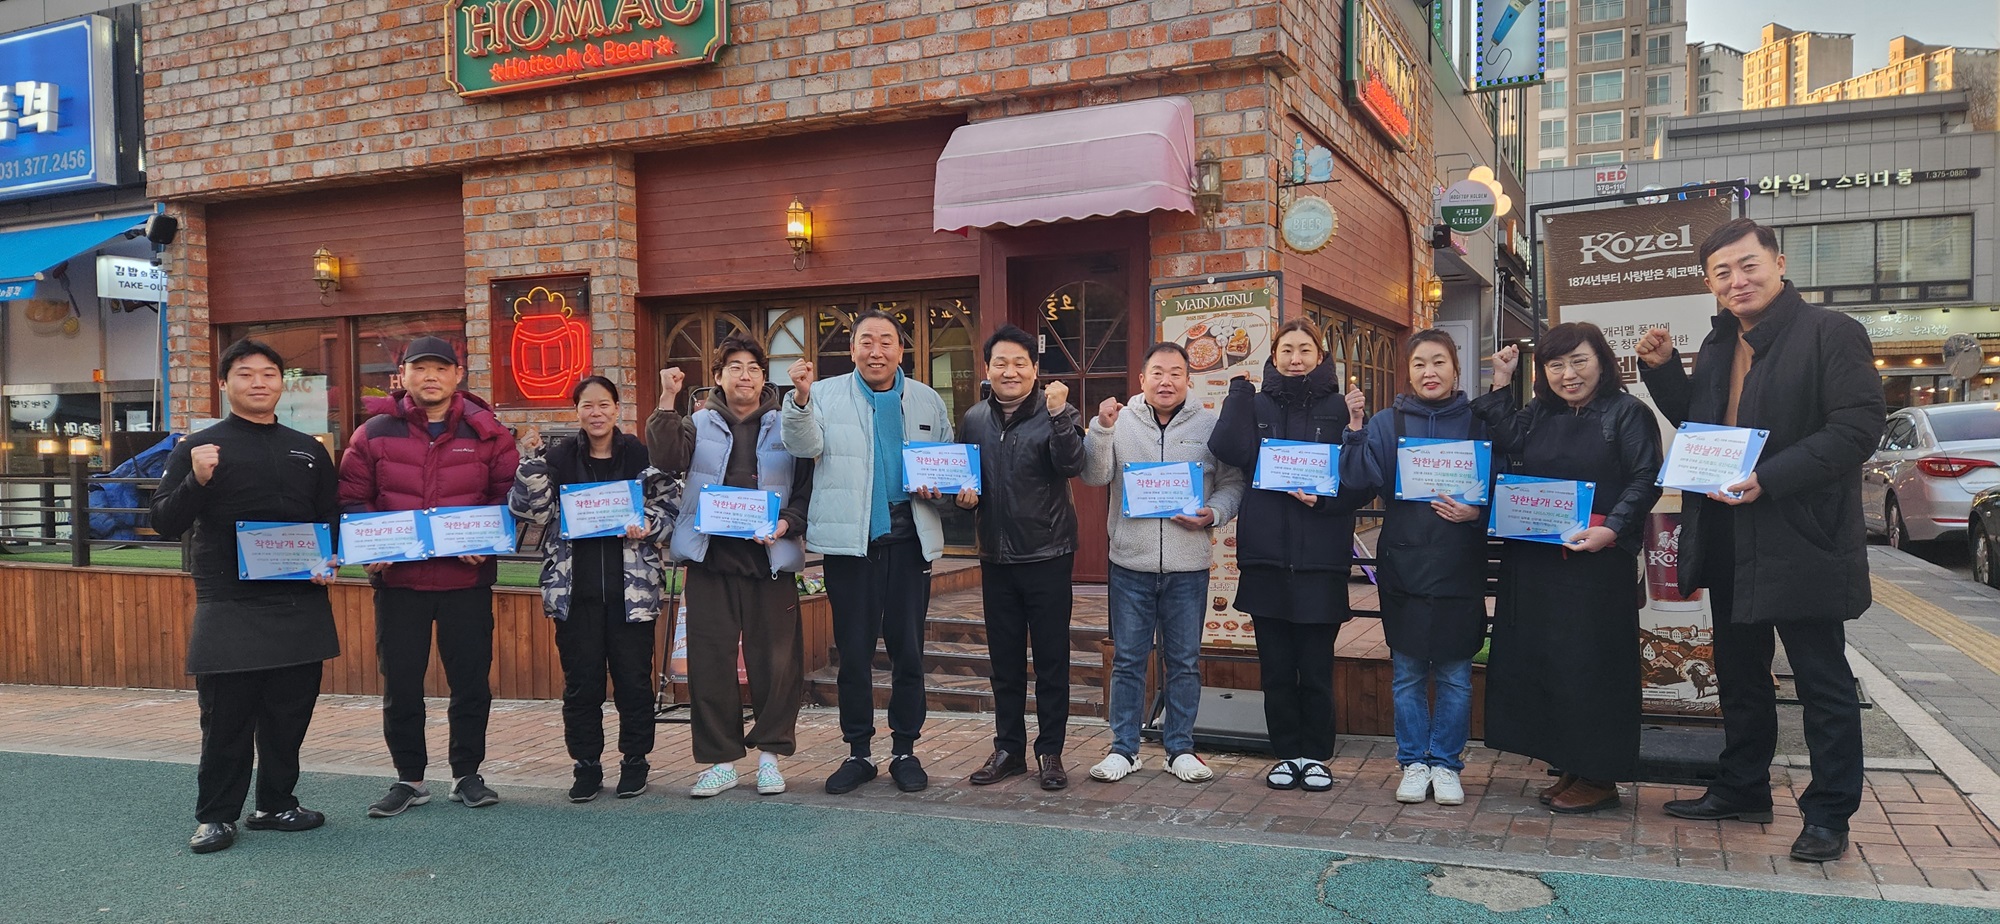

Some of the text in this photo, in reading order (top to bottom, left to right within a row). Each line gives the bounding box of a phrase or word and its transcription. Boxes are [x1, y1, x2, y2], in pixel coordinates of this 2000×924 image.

[503, 40, 653, 79] Hotteok & Beer
[1596, 170, 1627, 182] RED
[1925, 169, 1968, 179] T.375-0880
[1758, 174, 1810, 198] 학원
[1293, 218, 1322, 230] BEER
[1579, 224, 1694, 265] Kozel
[1568, 272, 1621, 287] 1874년부터
[1623, 269, 1664, 283] 사랑받은
[1176, 292, 1254, 312] MAIN MENU
[1603, 325, 1635, 337] 캐러멜
[1685, 443, 1742, 460] 착한날개 오산
[916, 456, 967, 467] 착한날개 오산
[1273, 454, 1327, 467] 착한날개 오산
[1412, 457, 1473, 470] 착한날개 오산
[1137, 479, 1189, 488] 착한날개 오산
[575, 498, 629, 509] 착한날개 오산
[712, 499, 765, 513] 착한날개 오산
[1510, 494, 1573, 510] 착한날개 오산
[444, 520, 500, 529] 착한날개 오산
[355, 526, 413, 536] 착한날개 오산
[255, 539, 315, 549] 착한날개 오산
